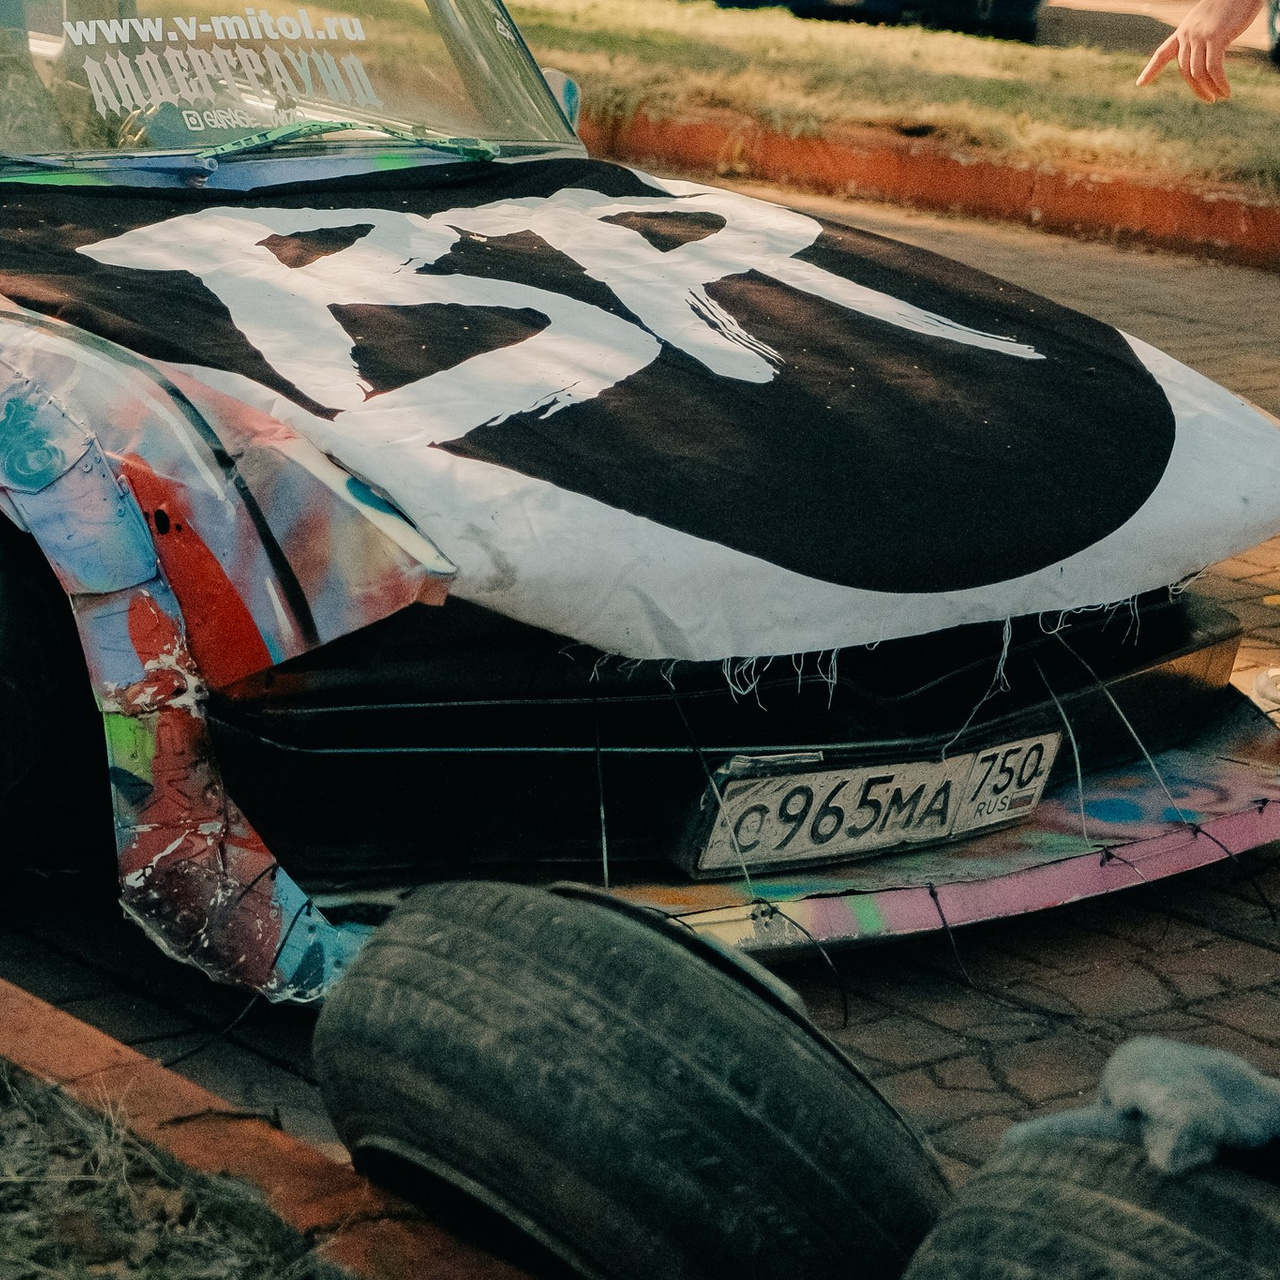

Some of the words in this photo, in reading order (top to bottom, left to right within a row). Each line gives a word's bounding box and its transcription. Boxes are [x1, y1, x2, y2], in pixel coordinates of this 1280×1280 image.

[62, 7, 366, 46] www.v-mitol.ru
[82, 42, 384, 120] АНДЕРГРАУНД
[731, 774, 952, 854] С965МА
[970, 742, 1045, 803] 750
[974, 795, 1008, 820] RUS
